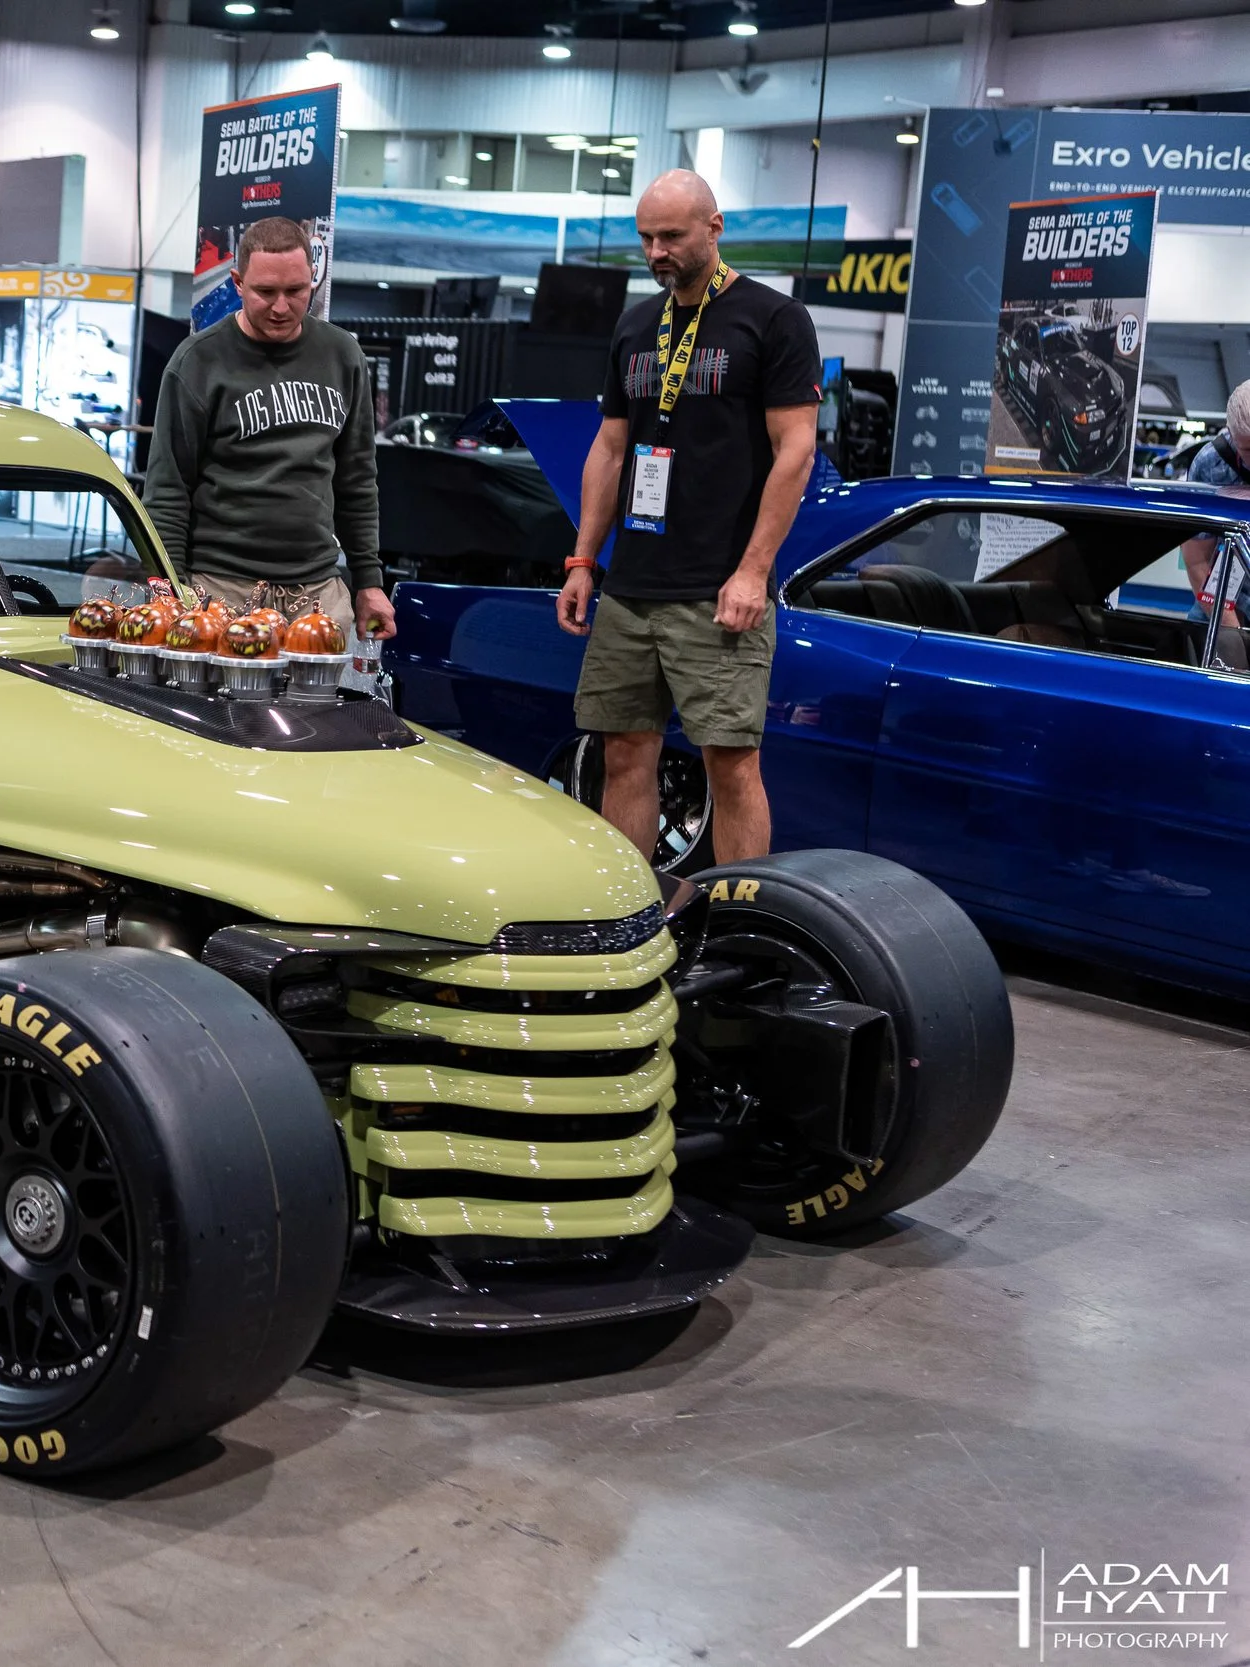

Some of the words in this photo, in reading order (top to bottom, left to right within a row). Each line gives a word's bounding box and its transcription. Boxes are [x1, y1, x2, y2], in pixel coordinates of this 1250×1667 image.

[220, 120, 245, 138] SEMA
[248, 113, 281, 134] BATTLE
[283, 110, 297, 127] OF
[299, 107, 317, 123] THE
[215, 126, 316, 177] BUILDERS
[1052, 140, 1131, 168] Exro
[1049, 181, 1117, 194] END-TO-END
[1028, 216, 1056, 230] SEMA
[1058, 212, 1094, 228] BATTLE
[1096, 210, 1110, 225] OF
[1113, 209, 1133, 223] THE
[1022, 225, 1131, 261] BUILDERS
[1052, 268, 1093, 282] MOTHERS
[1121, 321, 1136, 336] TOP
[1122, 337, 1132, 351] 12
[961, 387, 993, 396] VOLTAG
[235, 389, 270, 440] LOS
[270, 381, 347, 434] ANGELES
